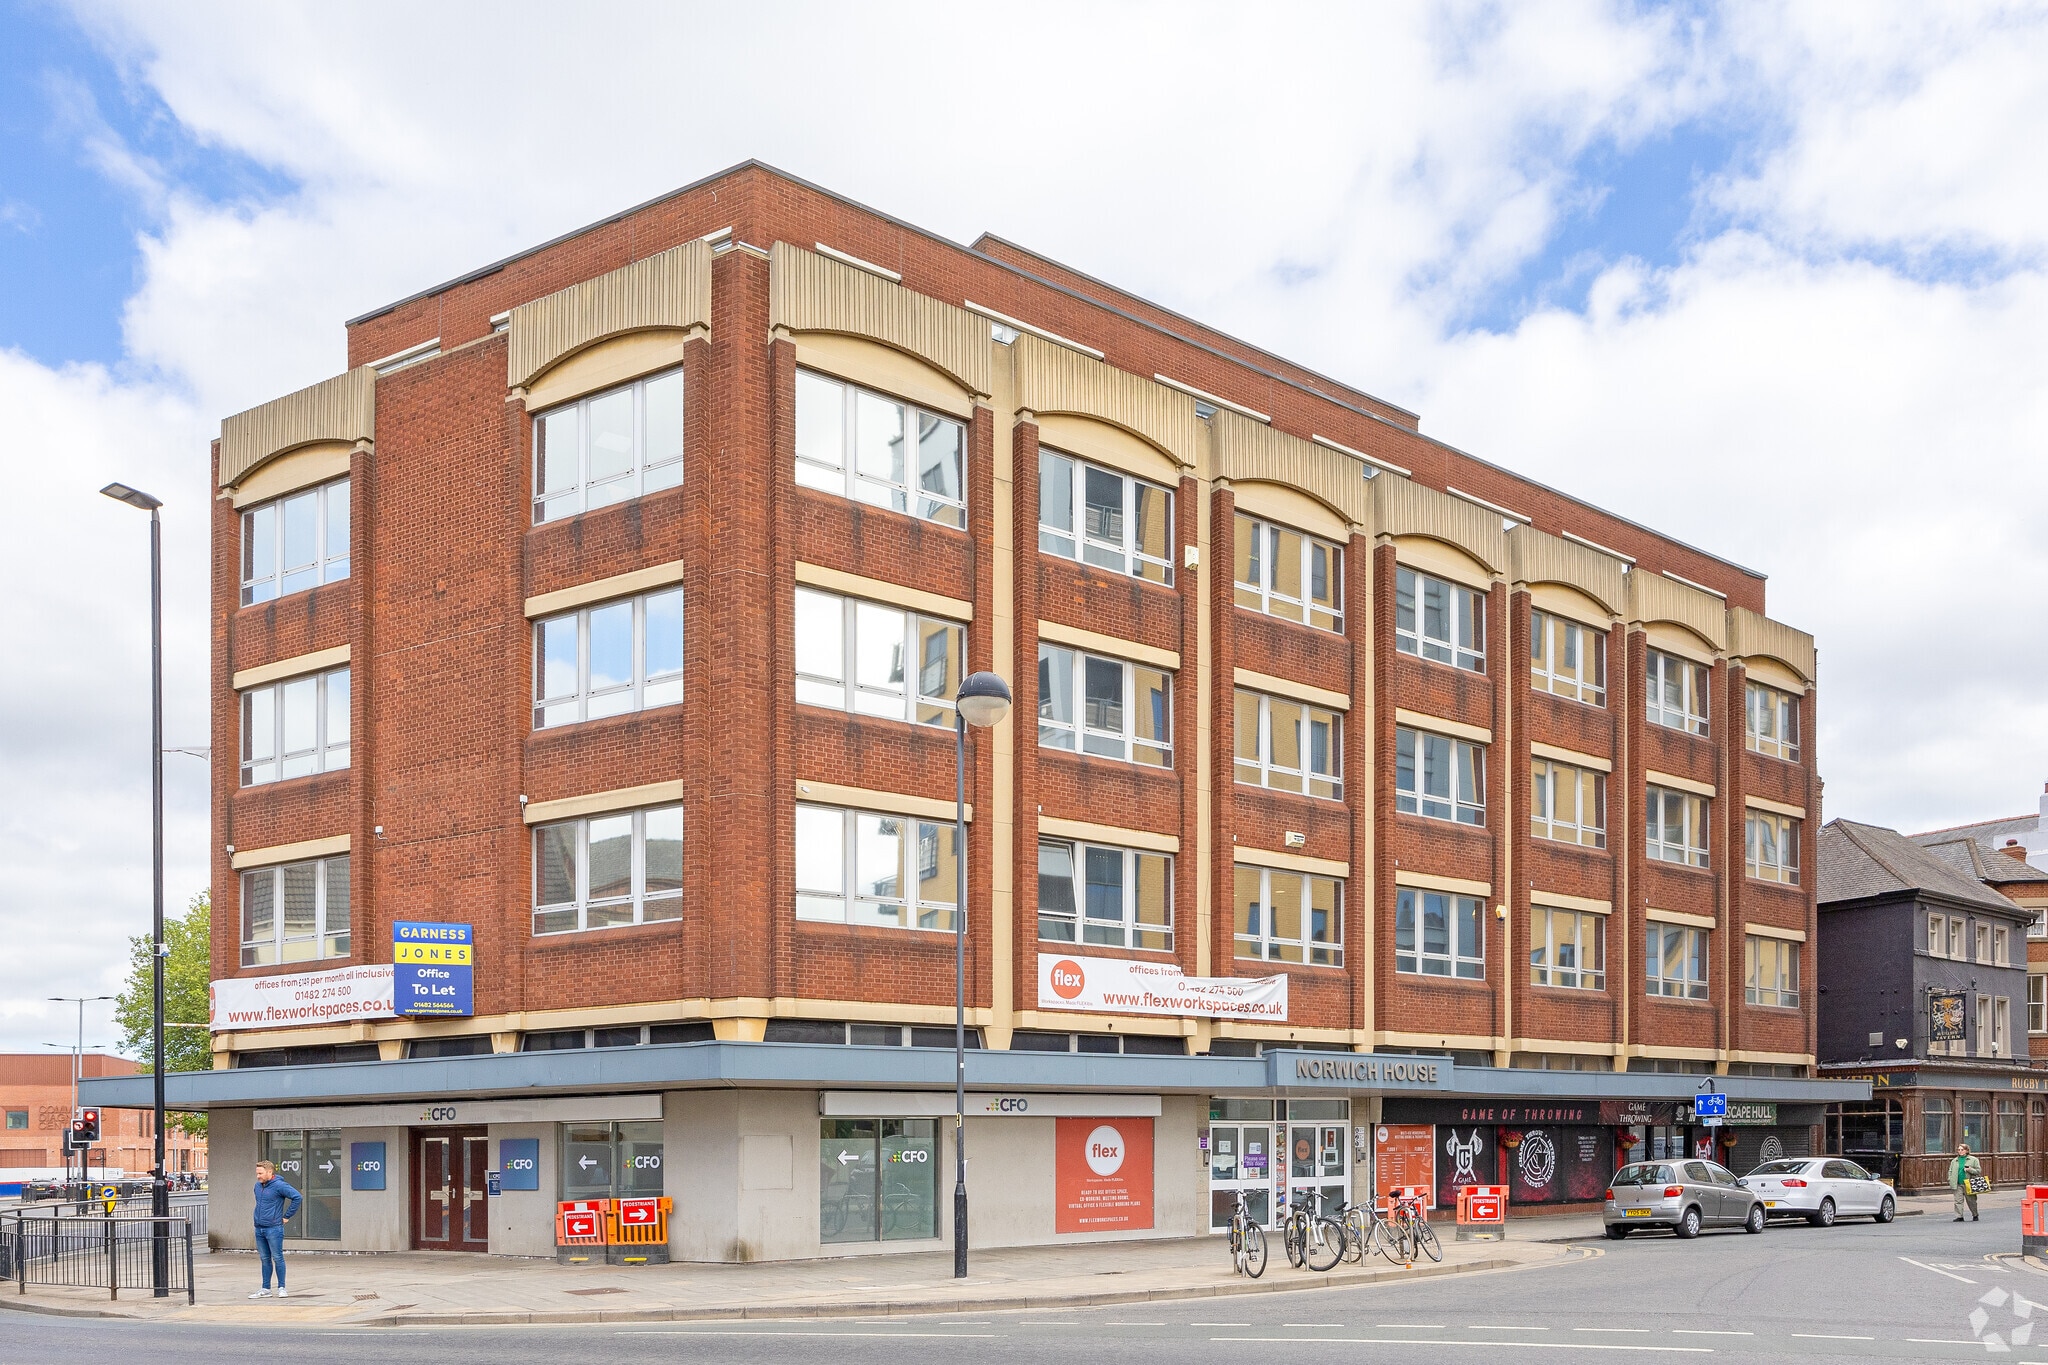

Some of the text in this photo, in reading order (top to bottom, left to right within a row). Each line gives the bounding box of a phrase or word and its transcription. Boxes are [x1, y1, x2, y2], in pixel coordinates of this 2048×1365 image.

[400, 926, 466, 940] GARNESS
[402, 948, 466, 960] JONES
[418, 968, 450, 978] Office
[1129, 964, 1182, 977] offices from
[254, 980, 280, 990] offices
[281, 978, 298, 988] from
[310, 978, 323, 987] per
[324, 974, 344, 984] month
[355, 967, 394, 980] inclusive
[1054, 968, 1082, 987] flex
[294, 986, 352, 1001] 01482 274 500
[412, 984, 456, 996] To Let
[1227, 987, 1244, 996] 500
[1103, 992, 1283, 1014] www.flexworkspaces.co.uk
[228, 999, 394, 1022] www.flexworkspaces.co.u
[1296, 1058, 1438, 1082] NORWICH HOUSE
[2012, 1078, 2039, 1090] RUGBY
[1000, 1098, 1028, 1112] CFO
[1628, 1102, 1646, 1112] GAME
[432, 1107, 456, 1121] CFO
[1462, 1108, 1582, 1120] GAME OF THROWING
[1722, 1106, 1772, 1118] SCAPE HULL
[1620, 1114, 1652, 1124] THROWING
[902, 1150, 928, 1163] CFO
[1092, 1144, 1118, 1158] flex
[282, 1160, 300, 1172] CFO
[363, 1162, 380, 1172] CFO
[514, 1159, 532, 1170] CFO
[634, 1156, 660, 1168] CFO
